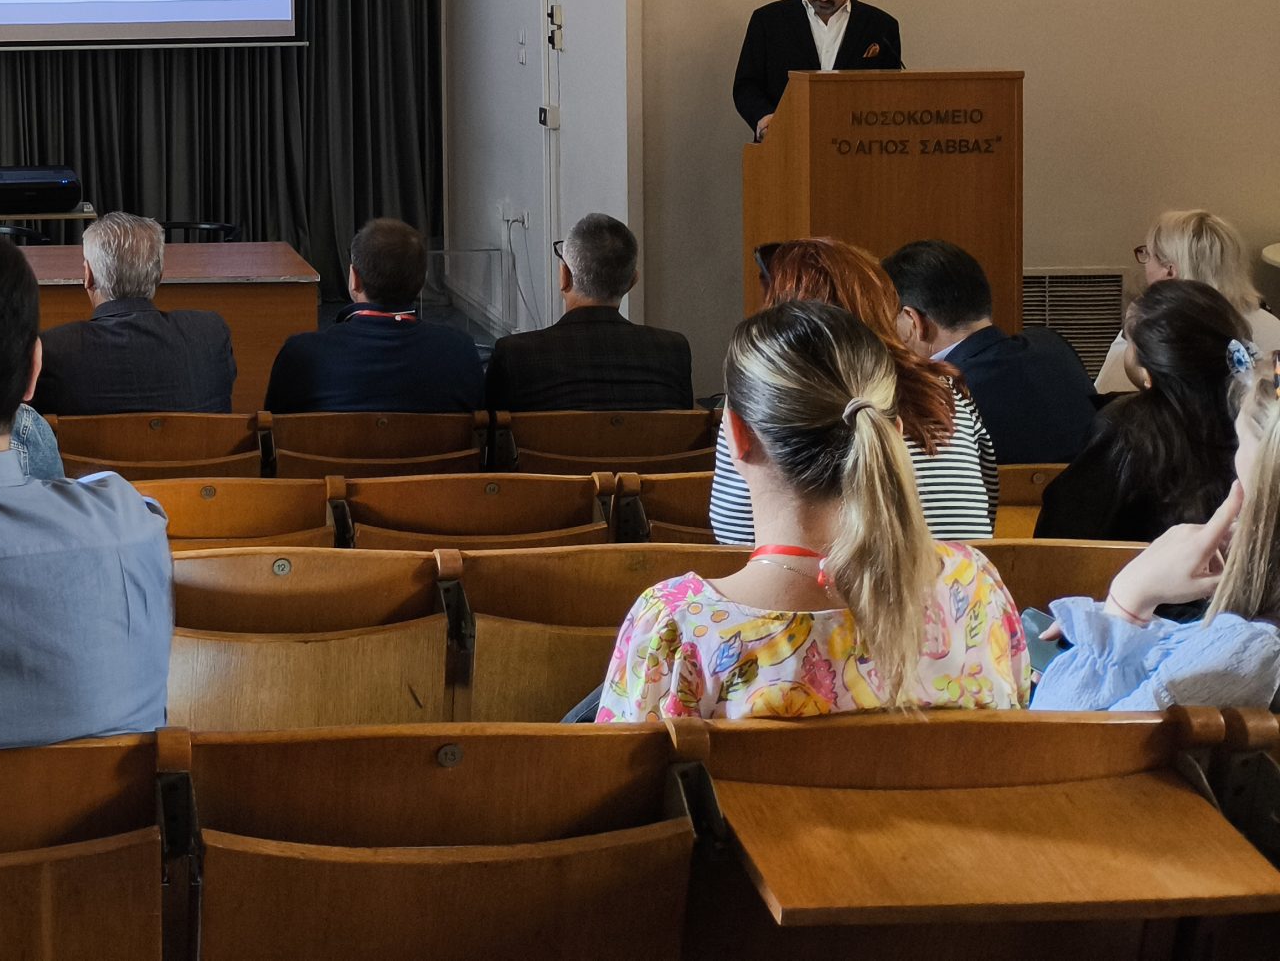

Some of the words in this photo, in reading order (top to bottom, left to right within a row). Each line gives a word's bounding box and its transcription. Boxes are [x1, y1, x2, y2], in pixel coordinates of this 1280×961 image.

[850, 108, 984, 127] ΝΟΣΟΚΟΜΕΙΟ
[855, 139, 910, 155] ΑΓΙΟΣ
[919, 135, 1003, 155] ΣΑΒΒΑΣ"
[276, 563, 286, 572] 12
[444, 751, 457, 762] 13
